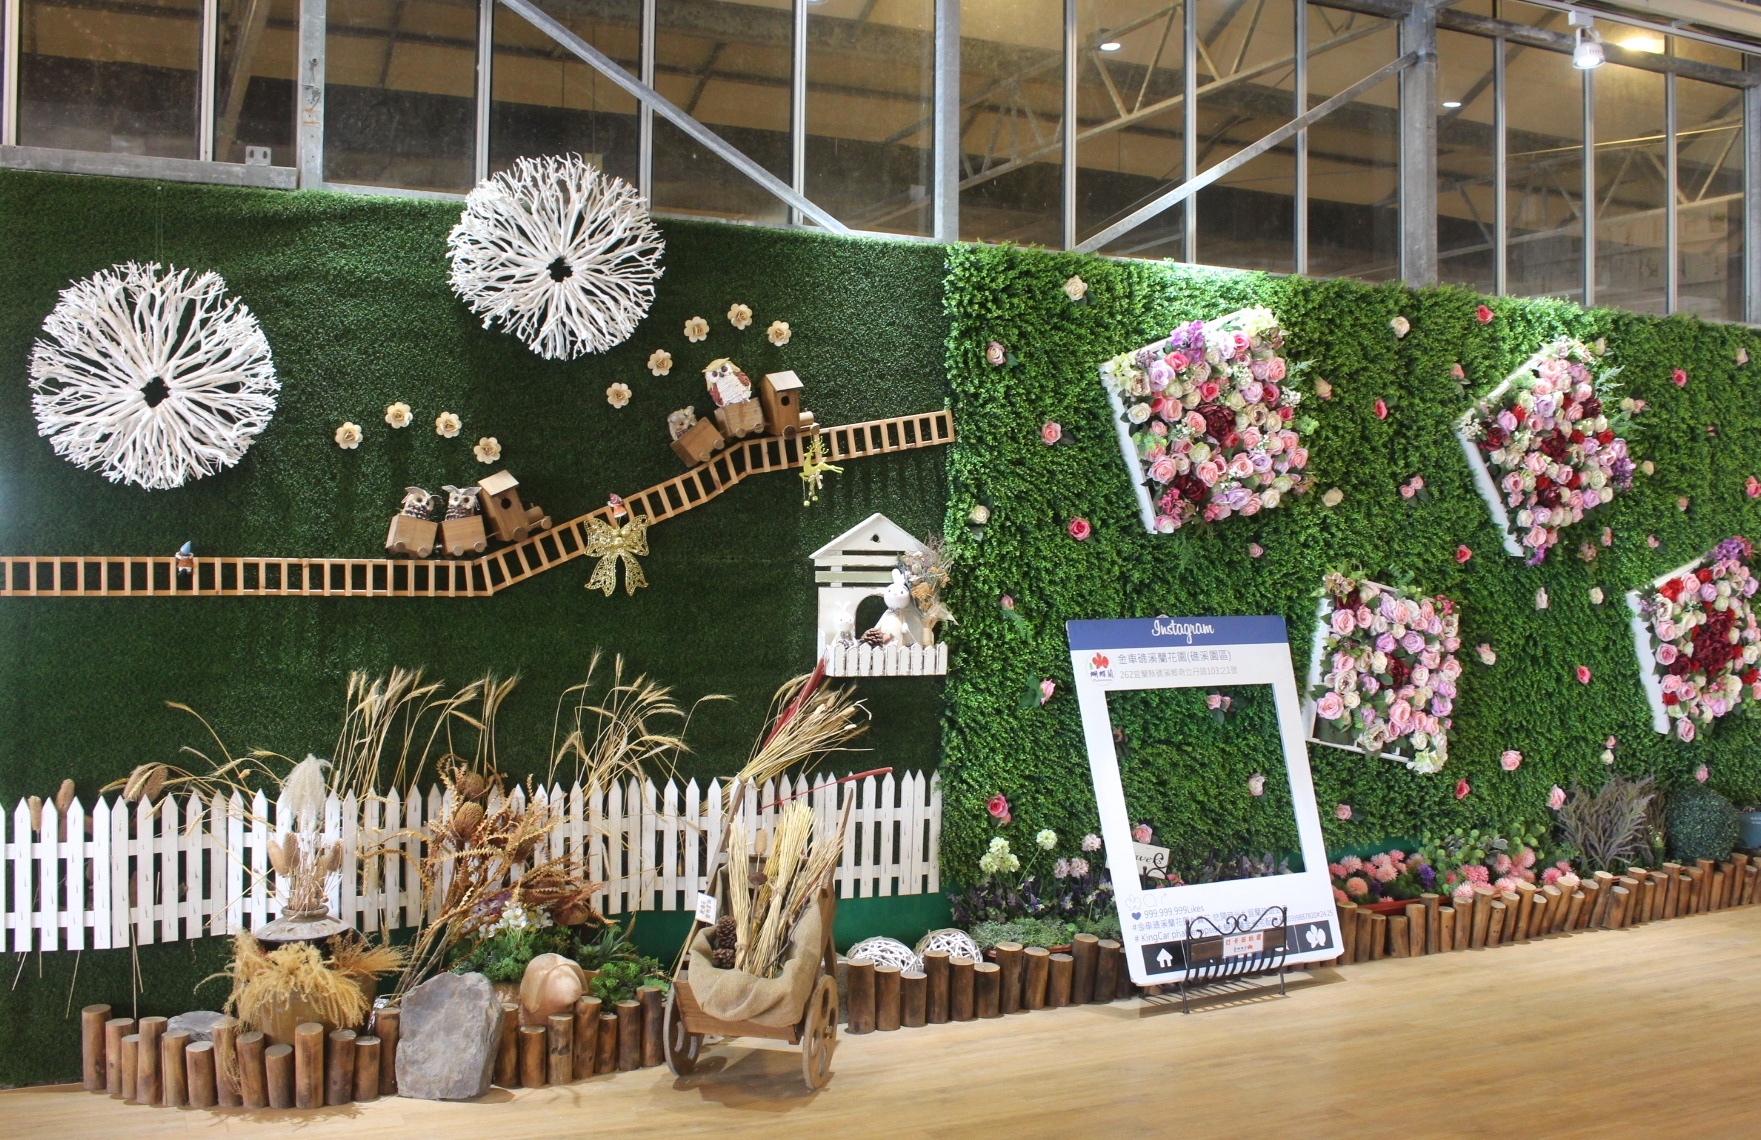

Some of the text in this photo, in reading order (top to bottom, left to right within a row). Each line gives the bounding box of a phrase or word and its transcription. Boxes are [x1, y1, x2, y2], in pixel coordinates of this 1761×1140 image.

[1151, 619, 1215, 644] Instagram
[1117, 650, 1231, 664] 金車礁溪蘭花園(礁溪園區)
